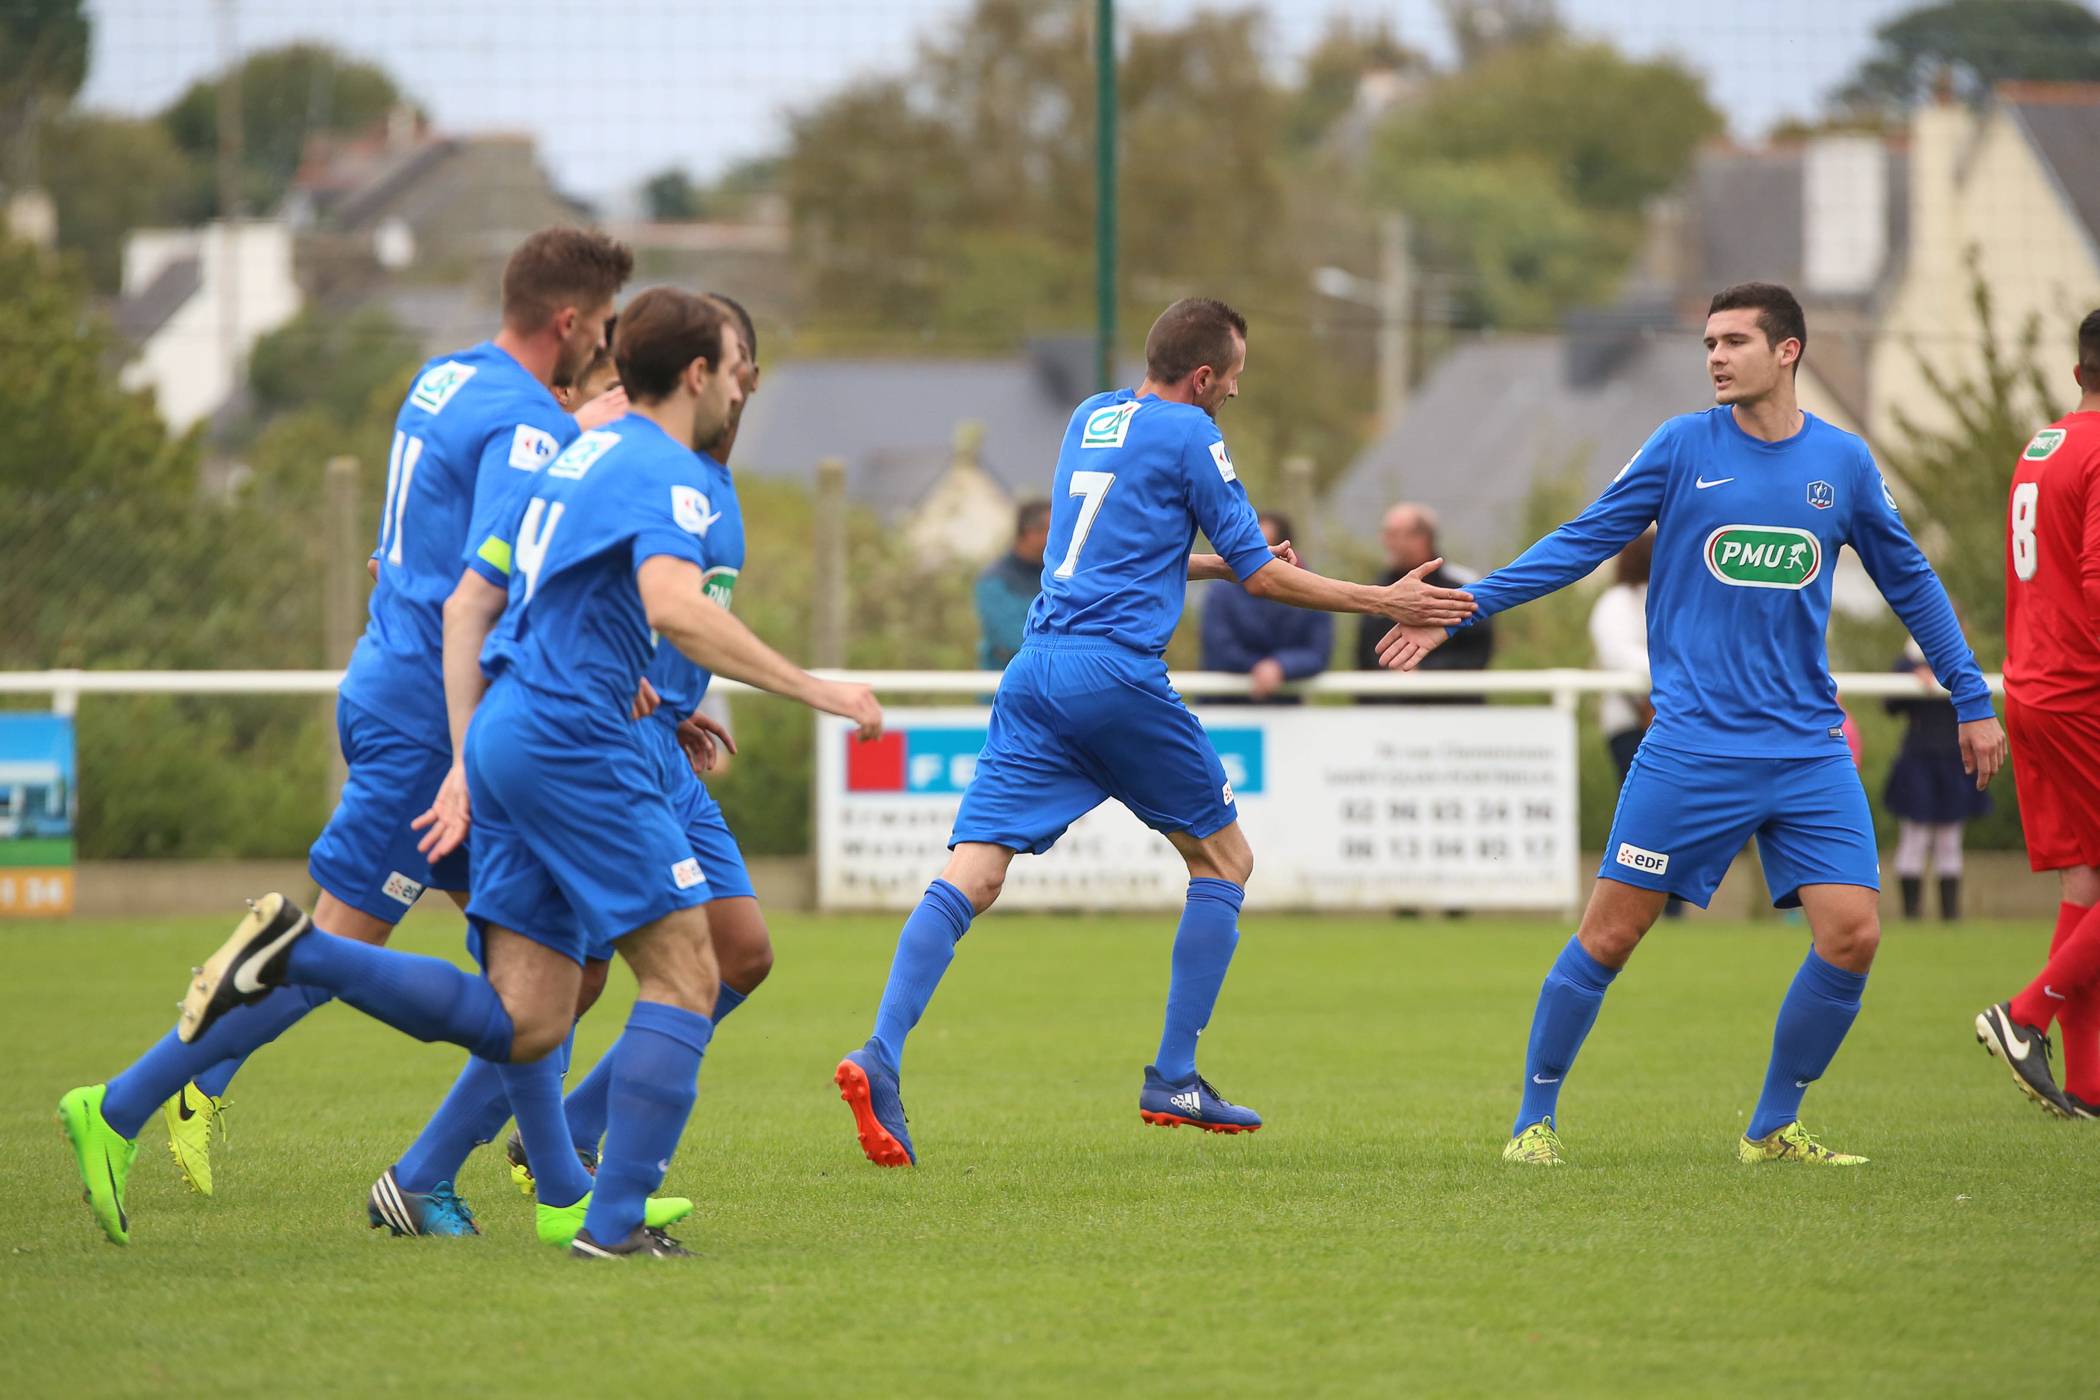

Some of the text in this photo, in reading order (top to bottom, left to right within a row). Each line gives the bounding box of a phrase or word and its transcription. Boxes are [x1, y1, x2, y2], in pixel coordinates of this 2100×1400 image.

[515, 497, 565, 604] 4
[1054, 471, 1116, 578] 7
[1720, 541, 1785, 569] PMU
[2011, 482, 2039, 582] 8
